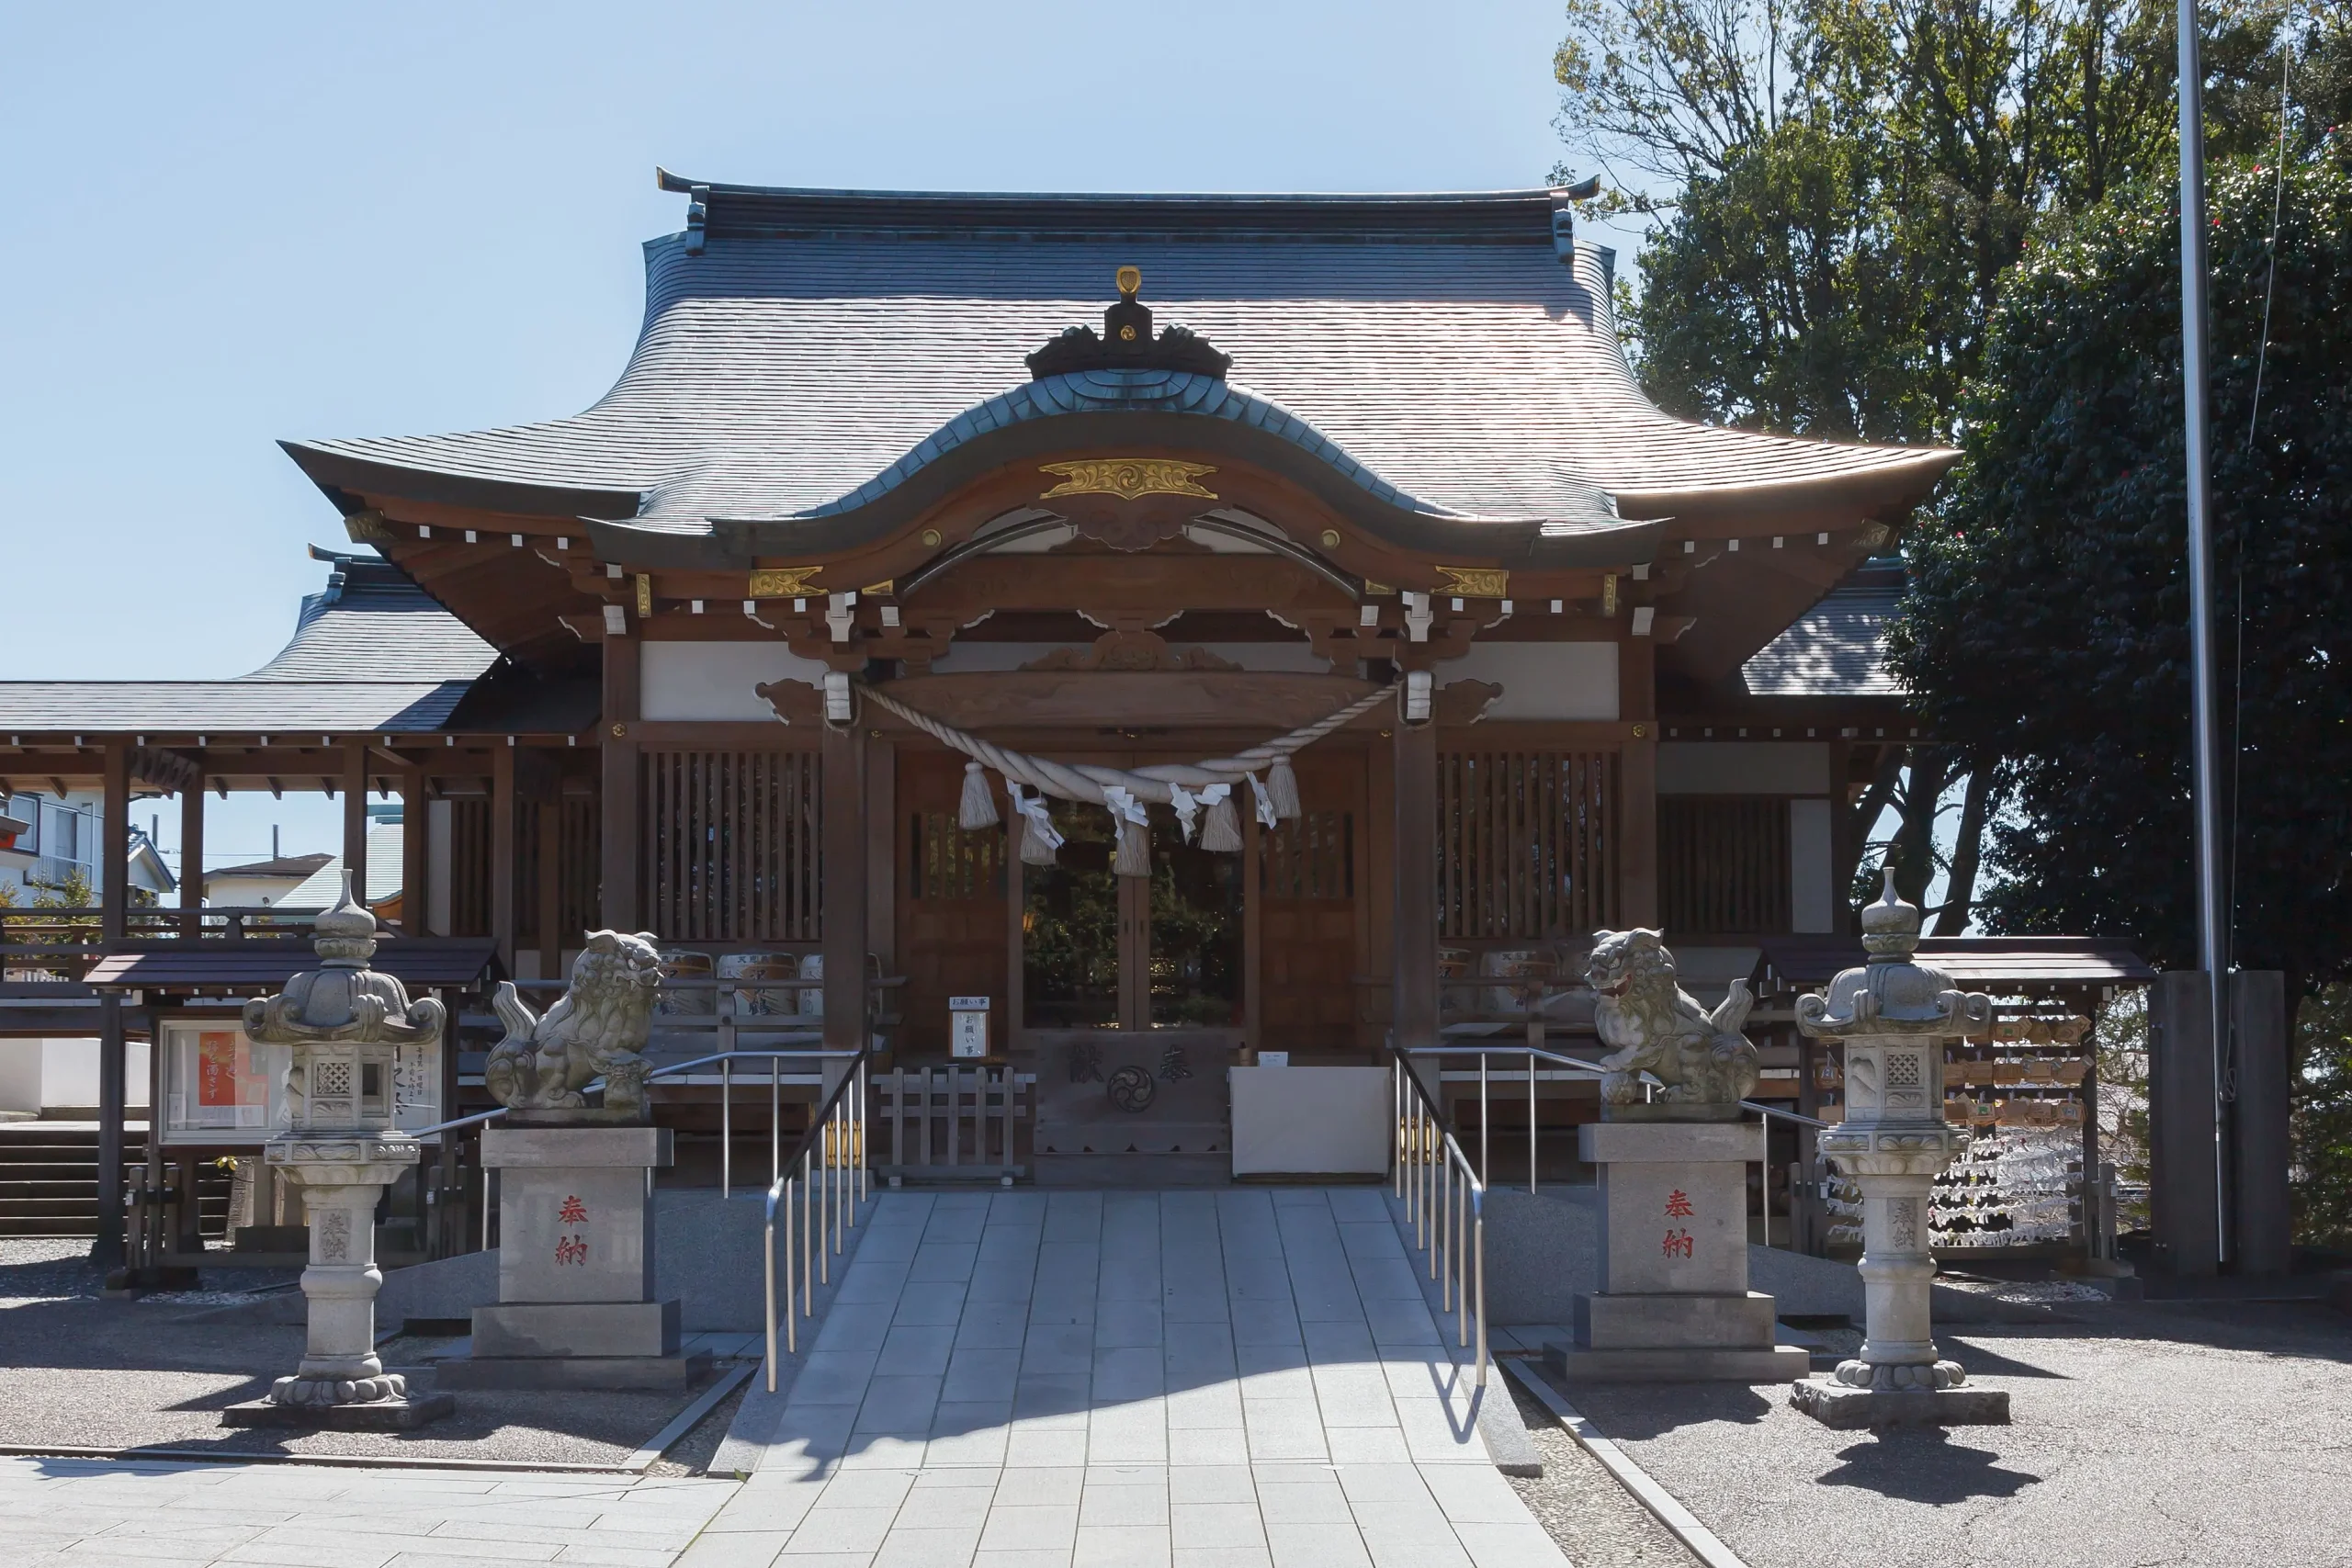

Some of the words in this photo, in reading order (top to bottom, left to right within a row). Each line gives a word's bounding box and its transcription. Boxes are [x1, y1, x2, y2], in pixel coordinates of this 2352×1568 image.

[952, 998, 987, 1007] お願い事
[964, 1014, 975, 1056] お願い事
[322, 1213, 350, 1260] 奉納
[555, 1195, 589, 1267] 奉納
[1661, 1189, 1695, 1259] 奉納
[1893, 1201, 1917, 1248] 奉納
